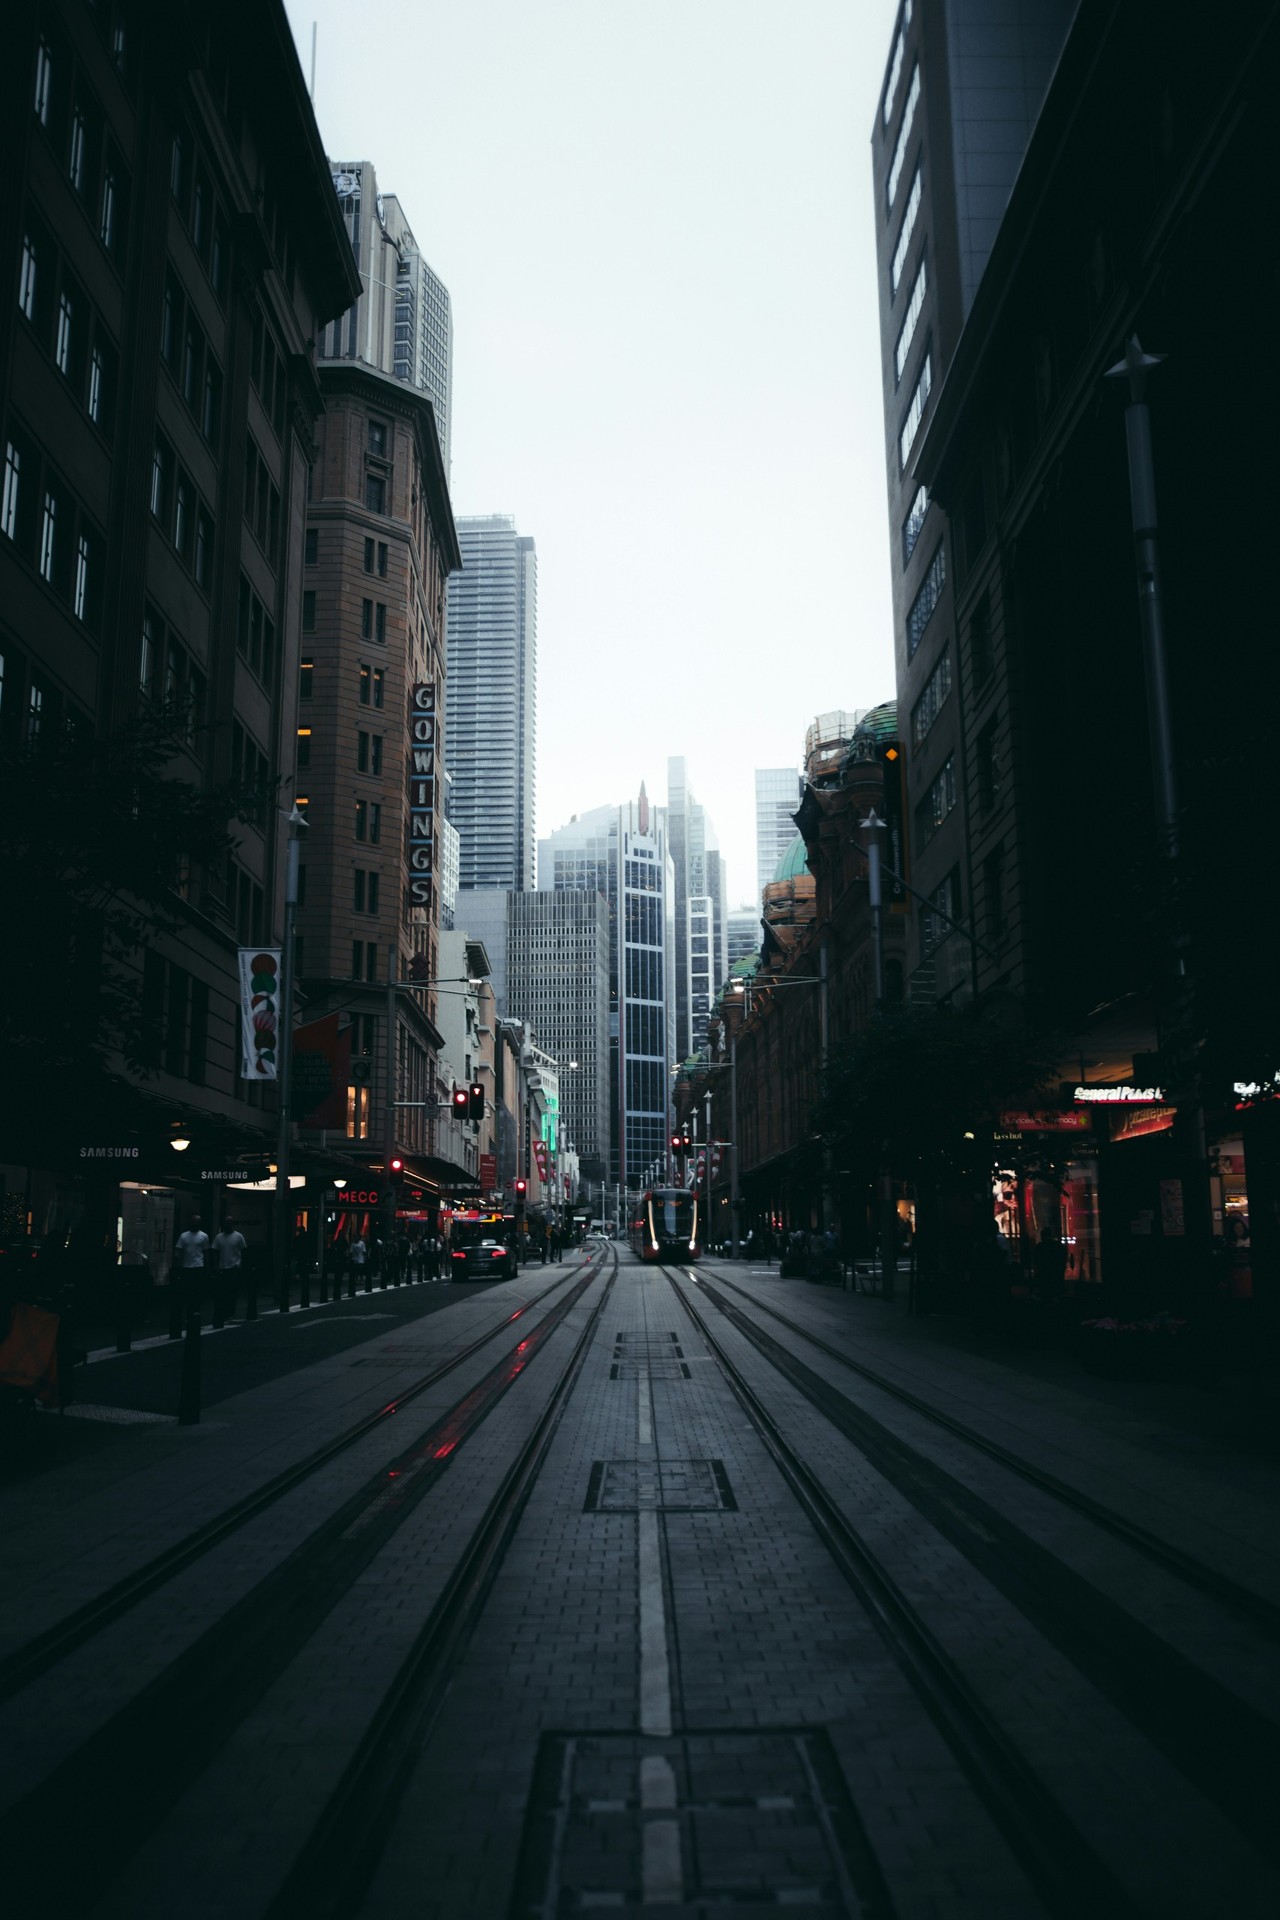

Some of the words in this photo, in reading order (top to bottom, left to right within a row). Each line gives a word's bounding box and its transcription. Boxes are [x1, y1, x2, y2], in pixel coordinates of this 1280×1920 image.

[411, 687, 433, 904] GOWINGS
[1073, 1086, 1122, 1100] General
[80, 1147, 139, 1158] SAMSUNG
[201, 1171, 248, 1180] SAMSUNG
[338, 1190, 379, 1204] MECC
